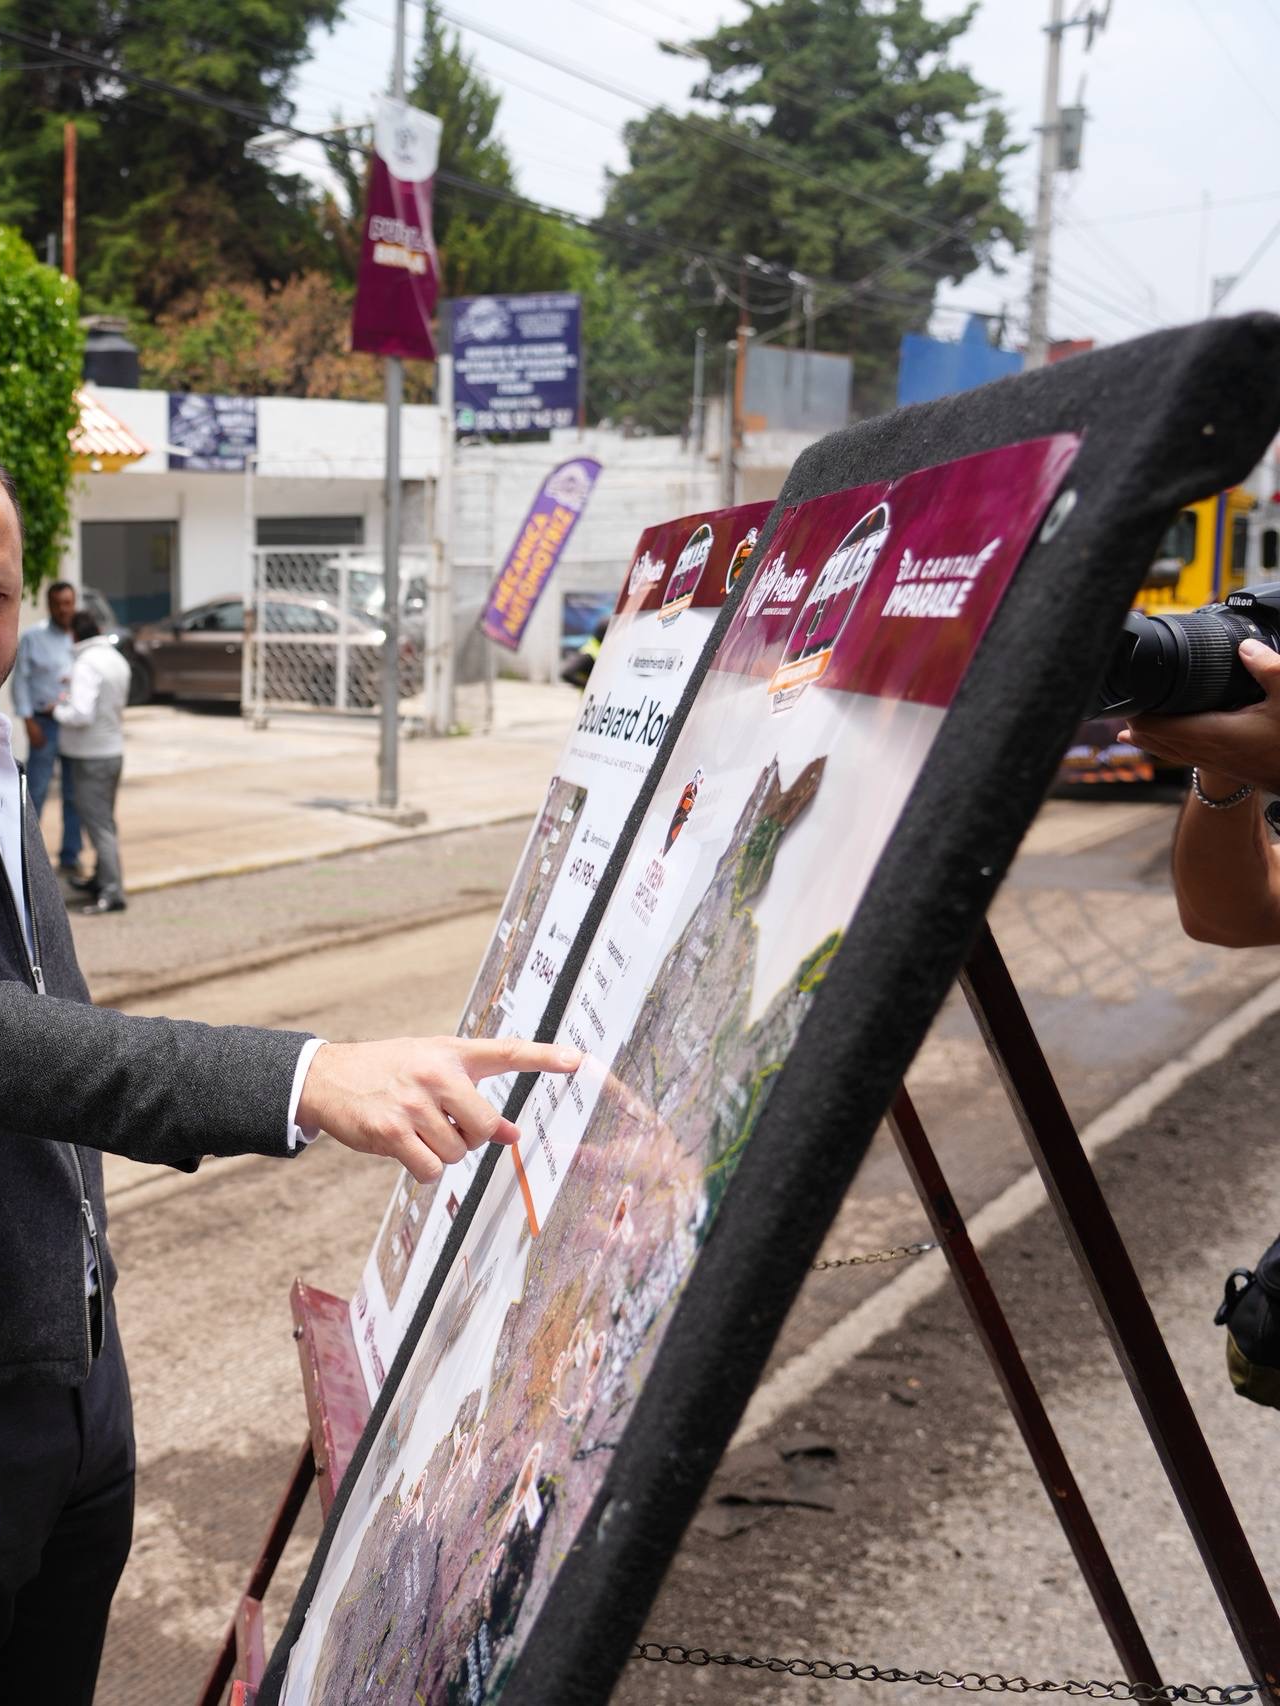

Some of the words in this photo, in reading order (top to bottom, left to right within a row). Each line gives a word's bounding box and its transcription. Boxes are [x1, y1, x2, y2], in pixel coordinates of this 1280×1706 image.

[901, 558, 922, 579] LA
[881, 579, 975, 618] IMPARABLE
[1227, 596, 1253, 606] Nikon
[577, 690, 648, 742] Boulevard
[569, 857, 596, 887] 69,198
